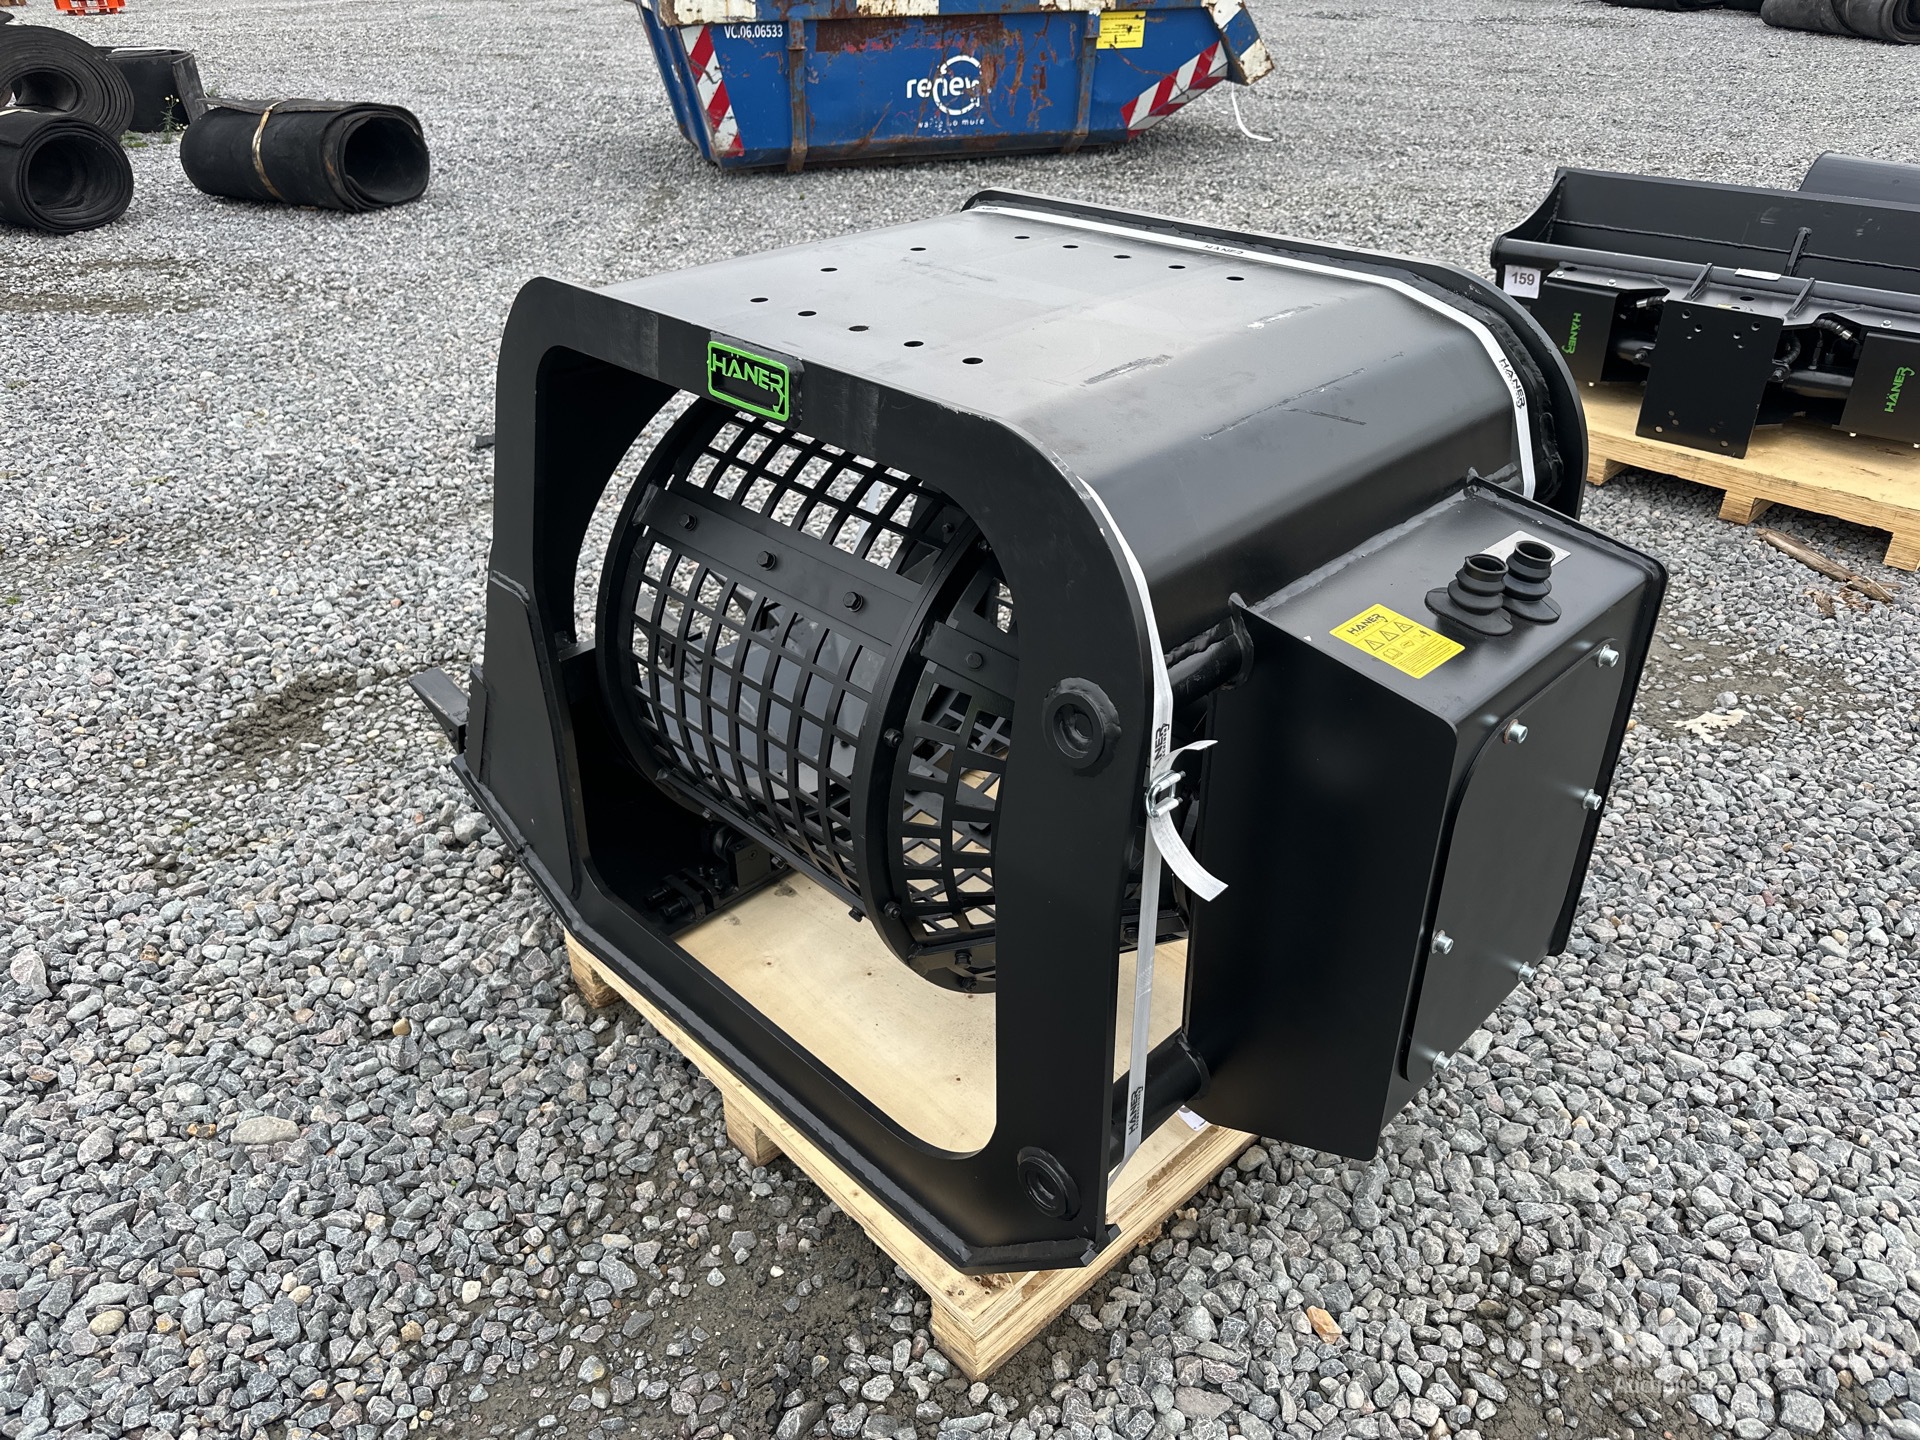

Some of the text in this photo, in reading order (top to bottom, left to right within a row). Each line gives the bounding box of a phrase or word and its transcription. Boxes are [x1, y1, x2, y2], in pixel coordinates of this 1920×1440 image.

[724, 24, 783, 39] VC.06.06533
[1511, 271, 1535, 286] 159
[1561, 312, 1582, 354] HÄNER
[711, 352, 784, 414] HÄNER
[1884, 366, 1916, 413] HÄNER
